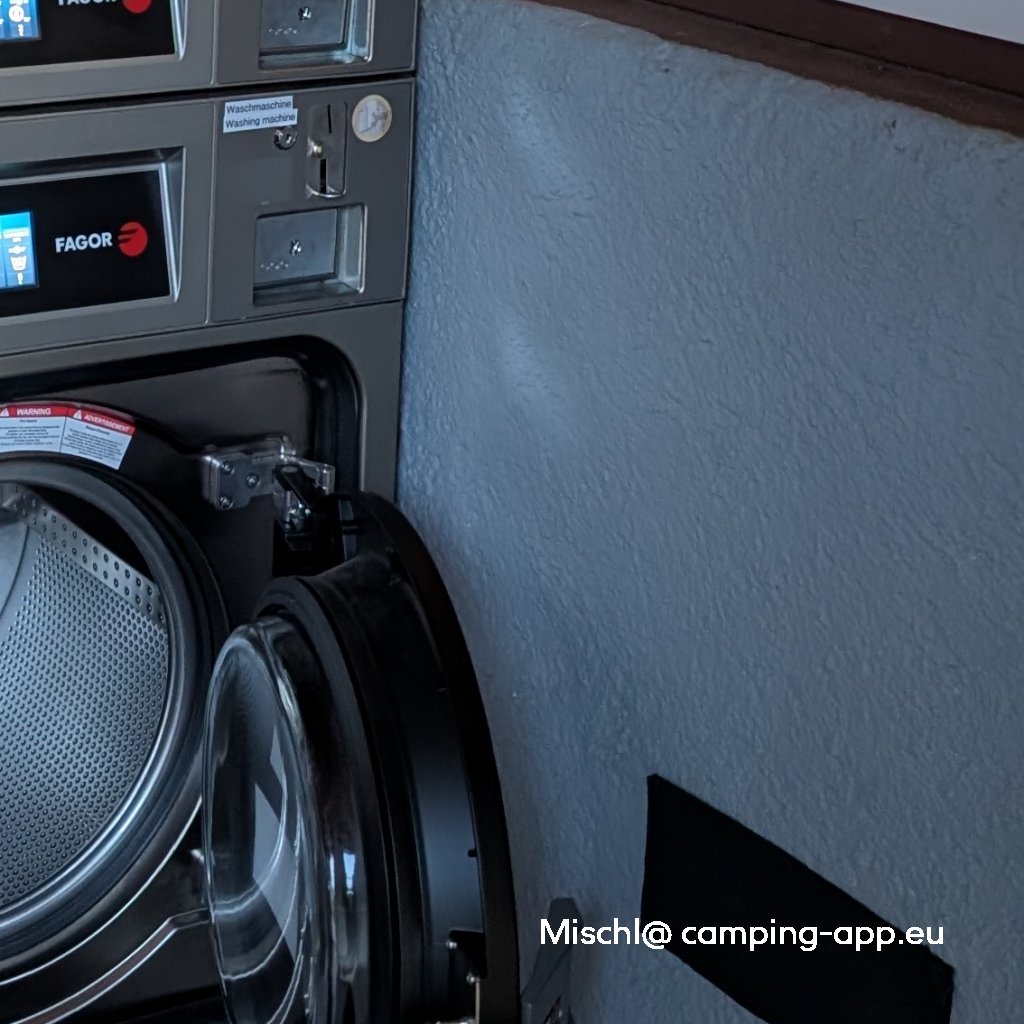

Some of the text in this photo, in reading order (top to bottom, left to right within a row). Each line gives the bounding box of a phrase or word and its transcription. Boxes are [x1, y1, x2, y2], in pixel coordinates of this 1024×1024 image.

[226, 100, 292, 114] Waschmaschine
[225, 112, 296, 129] Washing machine
[55, 232, 113, 253] FAGOR
[16, 407, 52, 416] WARNING
